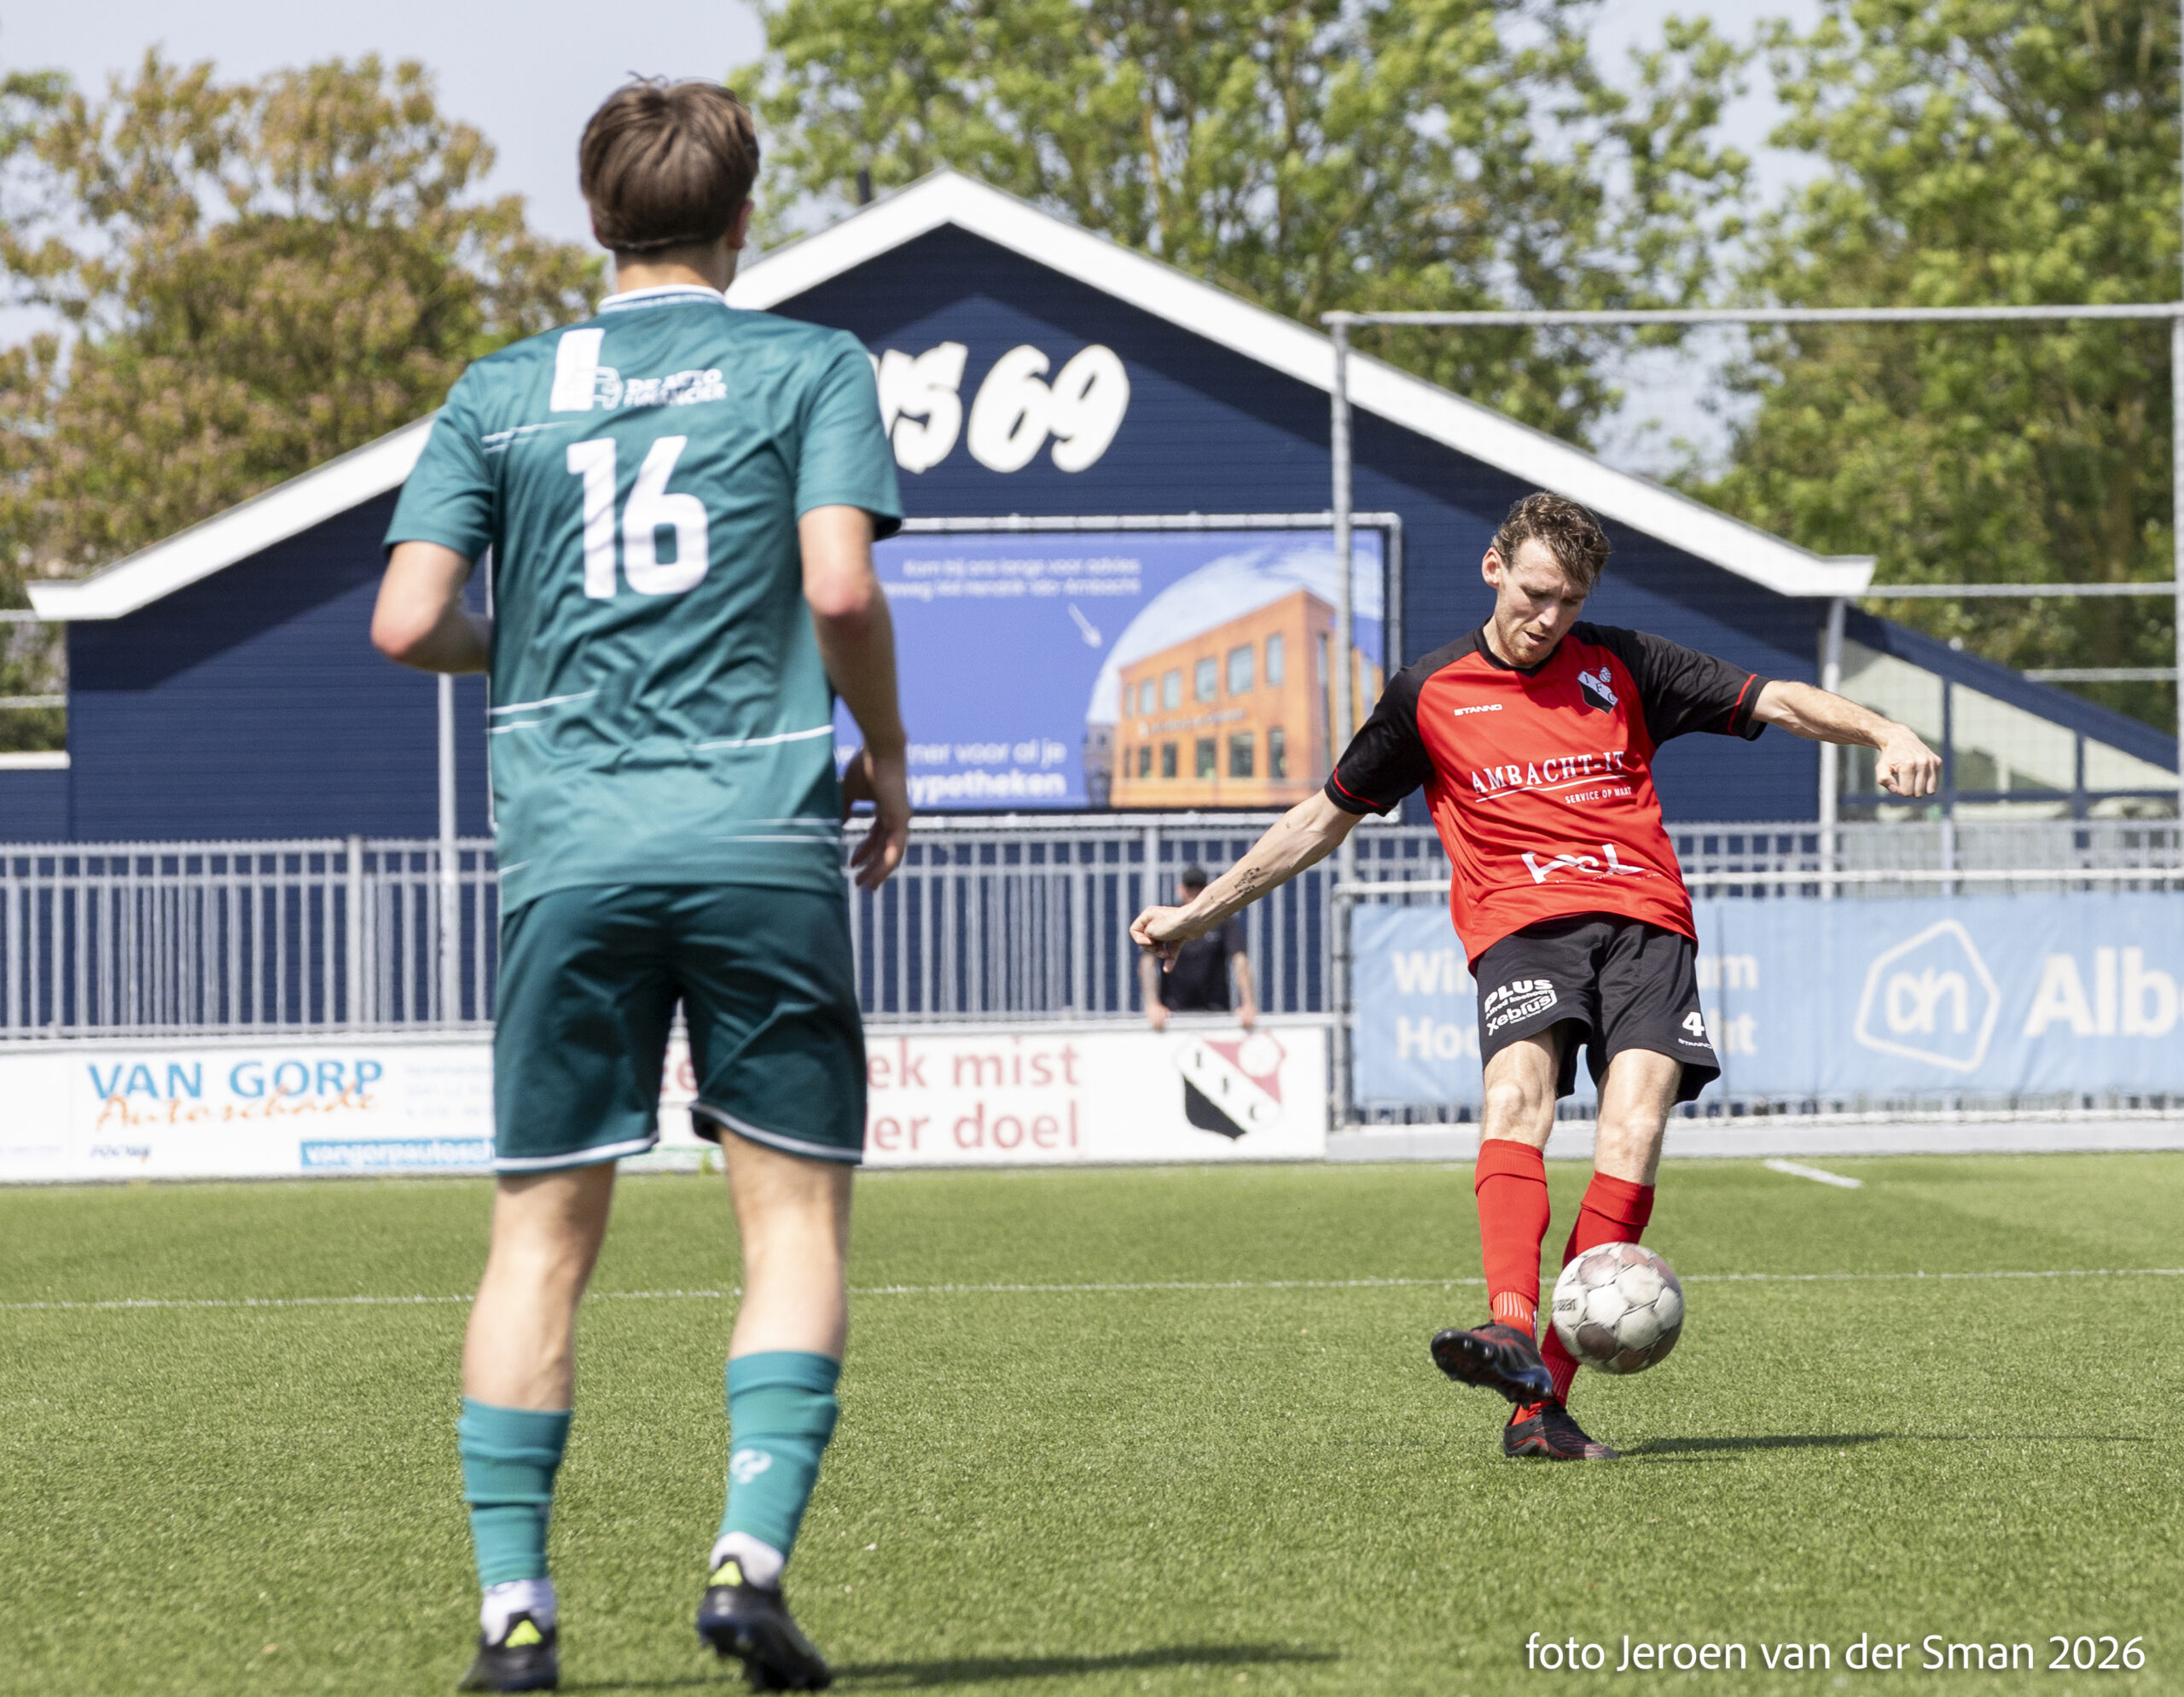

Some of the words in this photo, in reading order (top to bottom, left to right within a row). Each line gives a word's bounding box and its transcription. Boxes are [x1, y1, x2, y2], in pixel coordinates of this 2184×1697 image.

[967, 344, 1130, 473] 69
[566, 435, 710, 599] 16
[1454, 703, 1502, 716] STANNO
[954, 741, 1010, 766] voor
[1040, 737, 1067, 770] je
[1472, 750, 1624, 794] AMBACHT-IT
[905, 768, 1067, 806] ypotheken
[1565, 790, 1600, 805] SERVICE
[1602, 789, 1612, 799] OP
[1614, 786, 1632, 798] MAAT
[1484, 979, 1554, 1013] PLUS
[2023, 945, 2184, 1040] Alb
[1682, 1011, 1705, 1037] 4
[89, 1061, 203, 1100] VAN
[229, 1061, 383, 1098] GORP
[867, 1037, 927, 1089] ek
[952, 1036, 1079, 1088] mist
[953, 1100, 1078, 1150] doel
